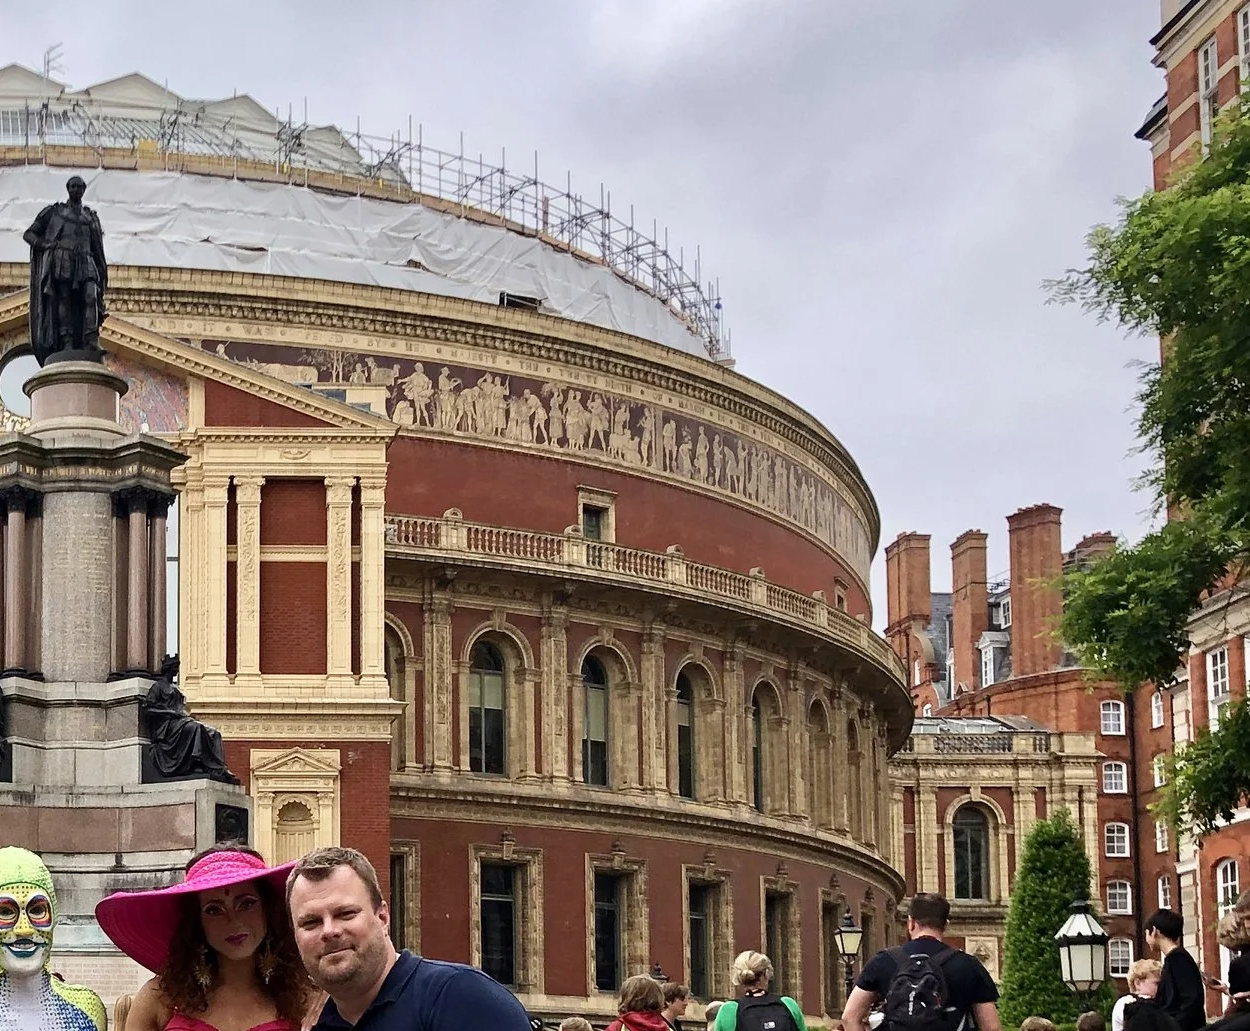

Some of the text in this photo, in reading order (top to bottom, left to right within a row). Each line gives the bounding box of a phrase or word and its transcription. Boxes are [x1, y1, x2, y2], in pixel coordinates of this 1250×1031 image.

[203, 321, 215, 332] IT
[242, 325, 272, 336] WAS
[367, 338, 382, 348] BY
